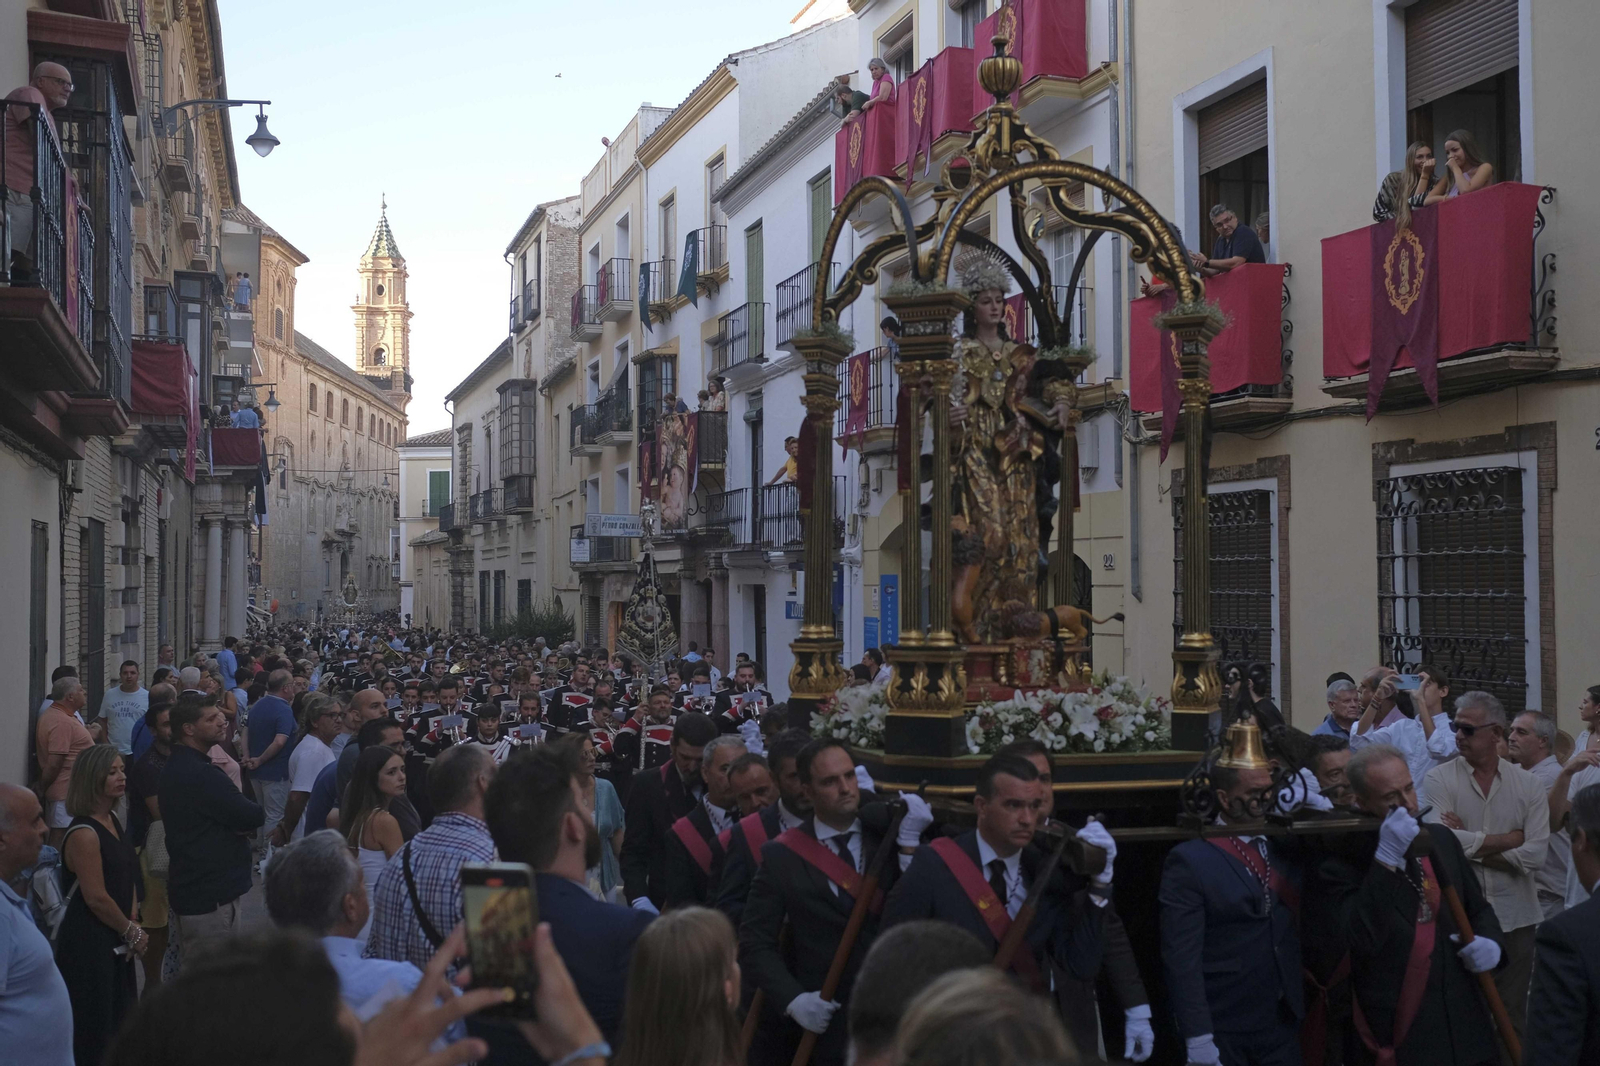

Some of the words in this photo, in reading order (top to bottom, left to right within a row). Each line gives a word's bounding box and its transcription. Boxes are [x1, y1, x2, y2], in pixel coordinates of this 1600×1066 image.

[1103, 554, 1114, 568] 22
[111, 701, 124, 709] GOOD
[125, 700, 141, 709] TIMES
